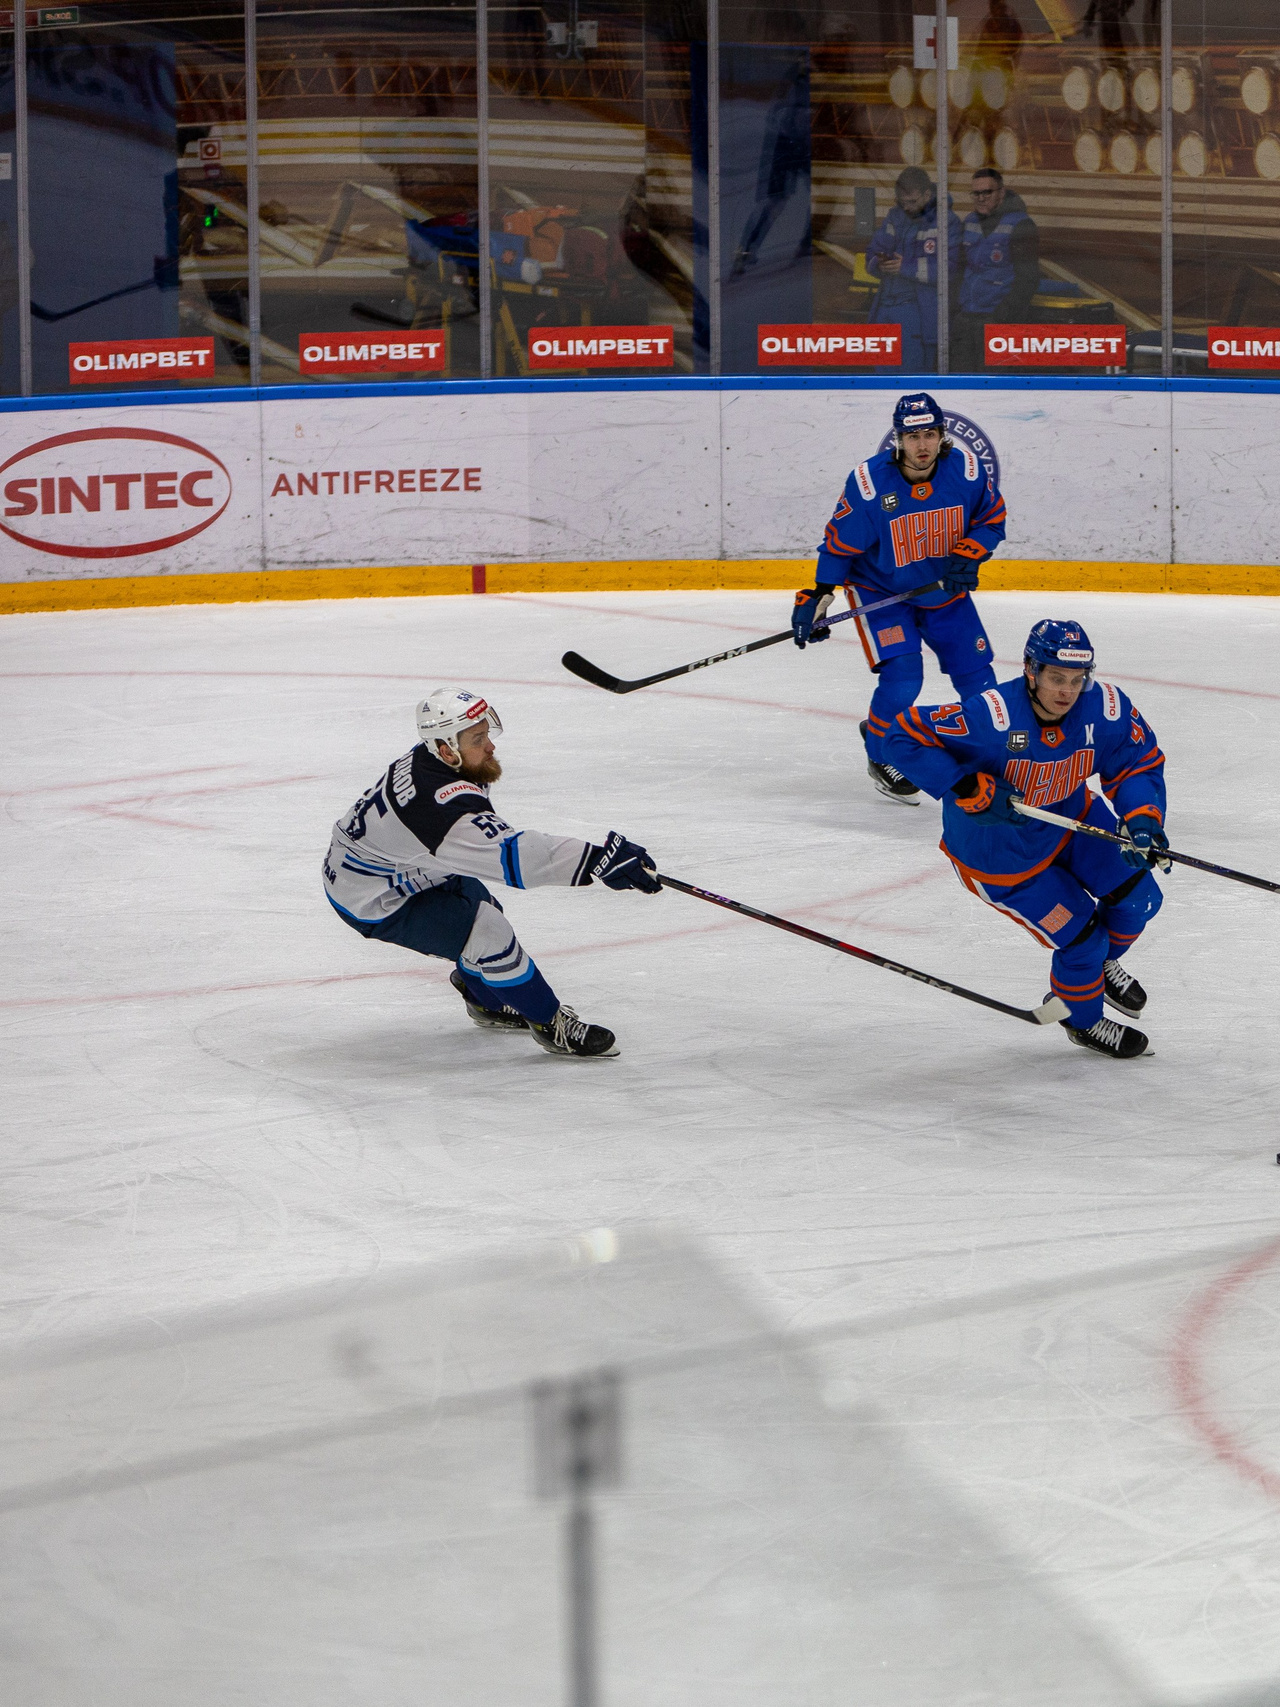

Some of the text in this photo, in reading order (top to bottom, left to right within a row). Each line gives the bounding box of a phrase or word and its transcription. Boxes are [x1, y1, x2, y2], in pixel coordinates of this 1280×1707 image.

[303, 342, 441, 362] OLIMPBET
[532, 338, 669, 357] OLIMPBET
[761, 336, 898, 353] OLIMPBET
[988, 337, 1122, 353] OLIMPBET
[73, 350, 210, 372] OLIMPBET
[270, 467, 482, 497] ANTIFREEZE
[4, 470, 213, 517] SINTEC
[688, 645, 748, 672] CCM
[1060, 651, 1090, 659] OLIMPBET
[986, 690, 1005, 726] LIMPBET
[930, 703, 969, 737] 47
[439, 784, 483, 800] OLIMPBET
